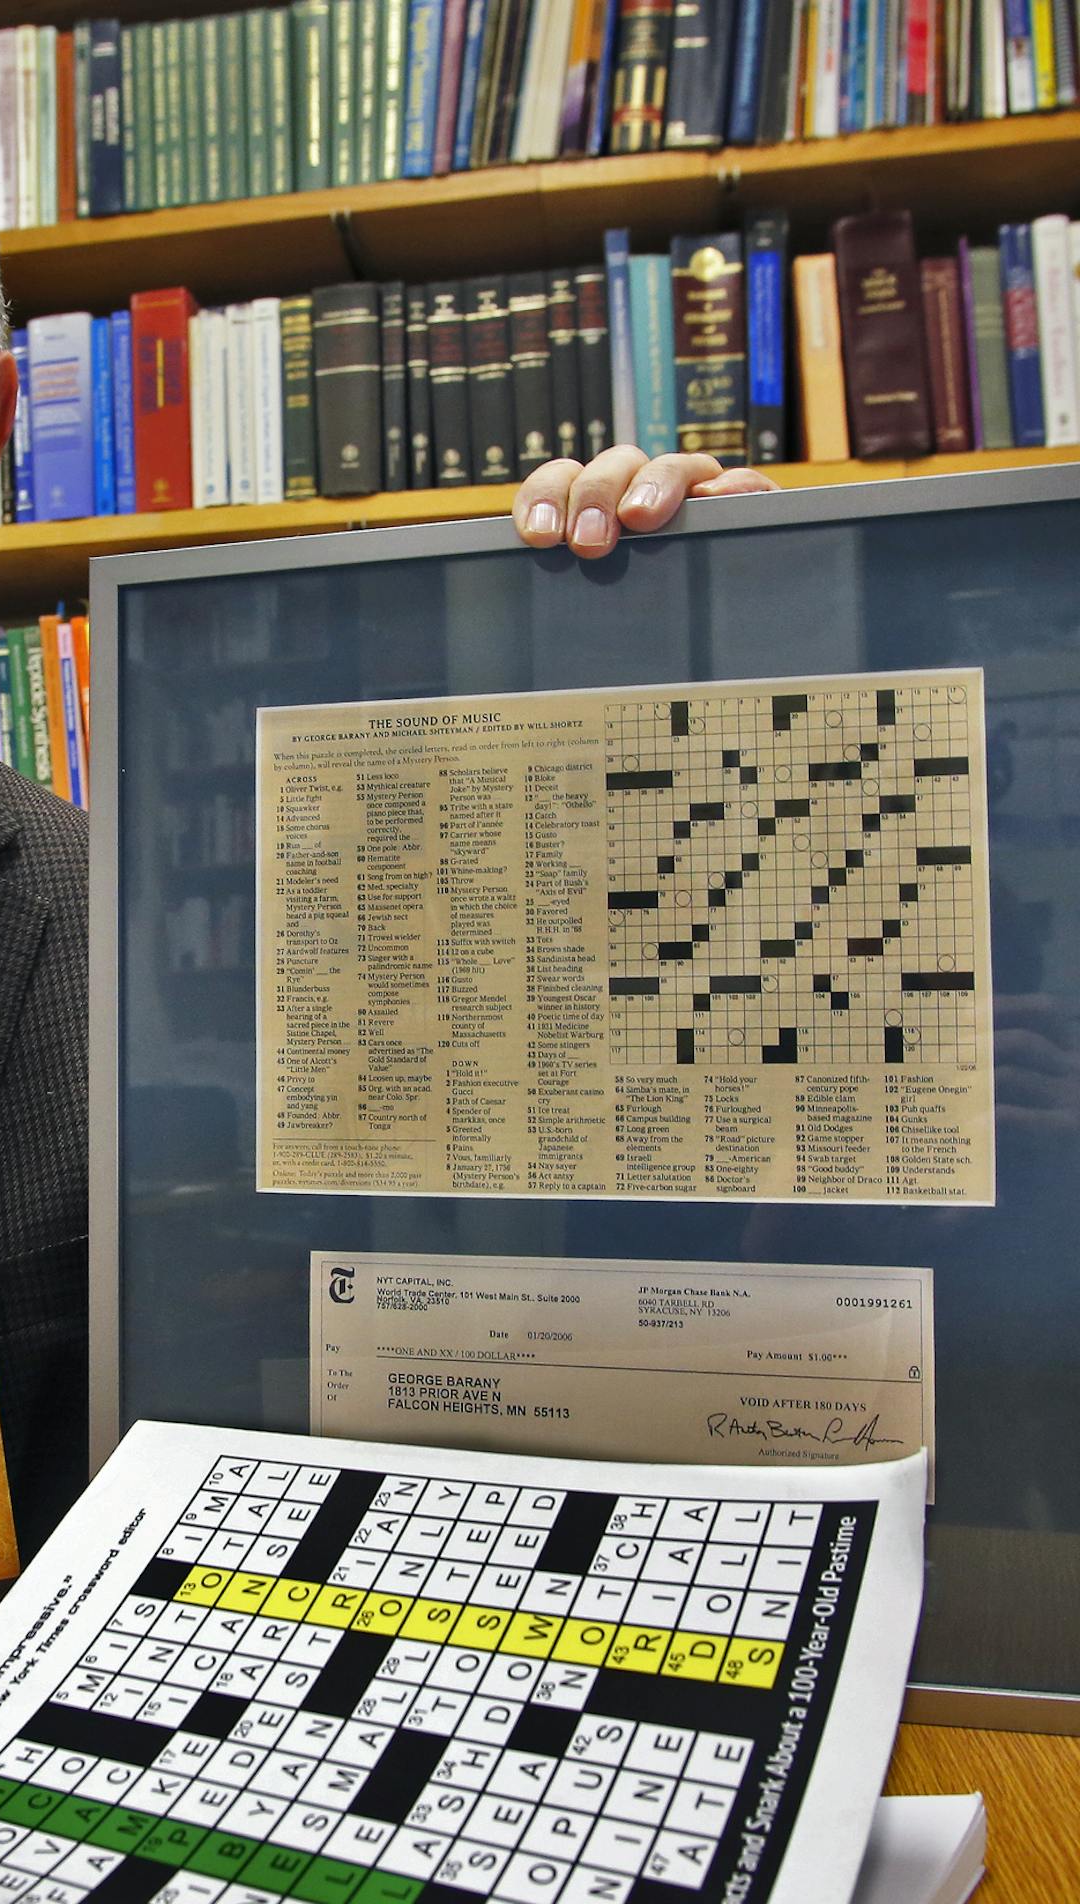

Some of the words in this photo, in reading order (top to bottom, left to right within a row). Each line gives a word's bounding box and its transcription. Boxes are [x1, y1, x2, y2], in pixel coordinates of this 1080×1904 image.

[369, 719, 392, 729] THE
[396, 716, 438, 728] SOUND
[443, 715, 458, 725] OF
[462, 712, 501, 724] MUSIC
[304, 734, 336, 742] GEORGE
[338, 732, 370, 741] BARANY
[391, 729, 426, 737] MICHAEL
[429, 726, 473, 735] SHTEYMAN
[482, 724, 512, 732] EDITED
[550, 720, 583, 728] SHORTZ
[534, 764, 564, 773] Chicago
[566, 763, 593, 771] district
[534, 821, 580, 830] Celebratory
[716, 1105, 761, 1114] Furloughed
[807, 1135, 832, 1143] Game
[902, 1167, 956, 1175] Understands
[903, 1187, 947, 1196] Basketball
[376, 1276, 393, 1284] NYT
[396, 1277, 434, 1286] CAPITAL,
[437, 1278, 454, 1286] INC.
[377, 1288, 402, 1297] World
[405, 1288, 426, 1297] Trade
[460, 1290, 473, 1299] 101
[476, 1292, 496, 1300] West
[498, 1293, 519, 1301] Main
[537, 1294, 558, 1303] Suite
[561, 1295, 580, 1303] 2000
[638, 1286, 648, 1295] JP
[650, 1287, 681, 1296] Morgan
[684, 1288, 708, 1297] Chase
[710, 1289, 730, 1297] Bank
[702, 1300, 714, 1308] RD
[836, 1297, 912, 1309] 0001991261
[638, 1319, 684, 1328] 50-937/213
[489, 1330, 509, 1339] Date
[528, 1332, 573, 1341] 01/20/2006
[326, 1343, 340, 1352] Pay
[418, 1348, 437, 1357] AND
[440, 1349, 454, 1358] XX
[461, 1350, 475, 1359] 100
[747, 1350, 763, 1360] Pay
[766, 1351, 802, 1361] Amount
[327, 1382, 349, 1390] Order
[388, 1373, 443, 1386] GEORGE
[446, 1376, 501, 1389] BARANY
[388, 1386, 415, 1397] 1813
[420, 1388, 458, 1400] PRIOR
[462, 1390, 488, 1401] AVE
[492, 1392, 501, 1401] N
[388, 1399, 439, 1412] FALCON
[443, 1401, 503, 1415] HEIGHTS,
[507, 1406, 526, 1416] MN
[534, 1407, 570, 1419] 55113
[740, 1397, 770, 1407] VOID
[772, 1399, 811, 1410] AFTER
[814, 1401, 832, 1410] 180
[835, 1401, 867, 1412] DAYS
[758, 1448, 800, 1458] Authorized
[803, 1450, 840, 1461] Signature
[821, 1515, 857, 1584] Pastime
[10, 1658, 39, 1685] York
[36, 1618, 69, 1653] Times
[69, 1549, 119, 1615] crossword
[118, 1508, 146, 1546] editor
[789, 1586, 840, 1704] 100-Year-Old
[790, 1707, 807, 1720] a
[766, 1720, 803, 1778] About
[746, 1776, 785, 1834] Snark
[734, 1833, 765, 1873] and
